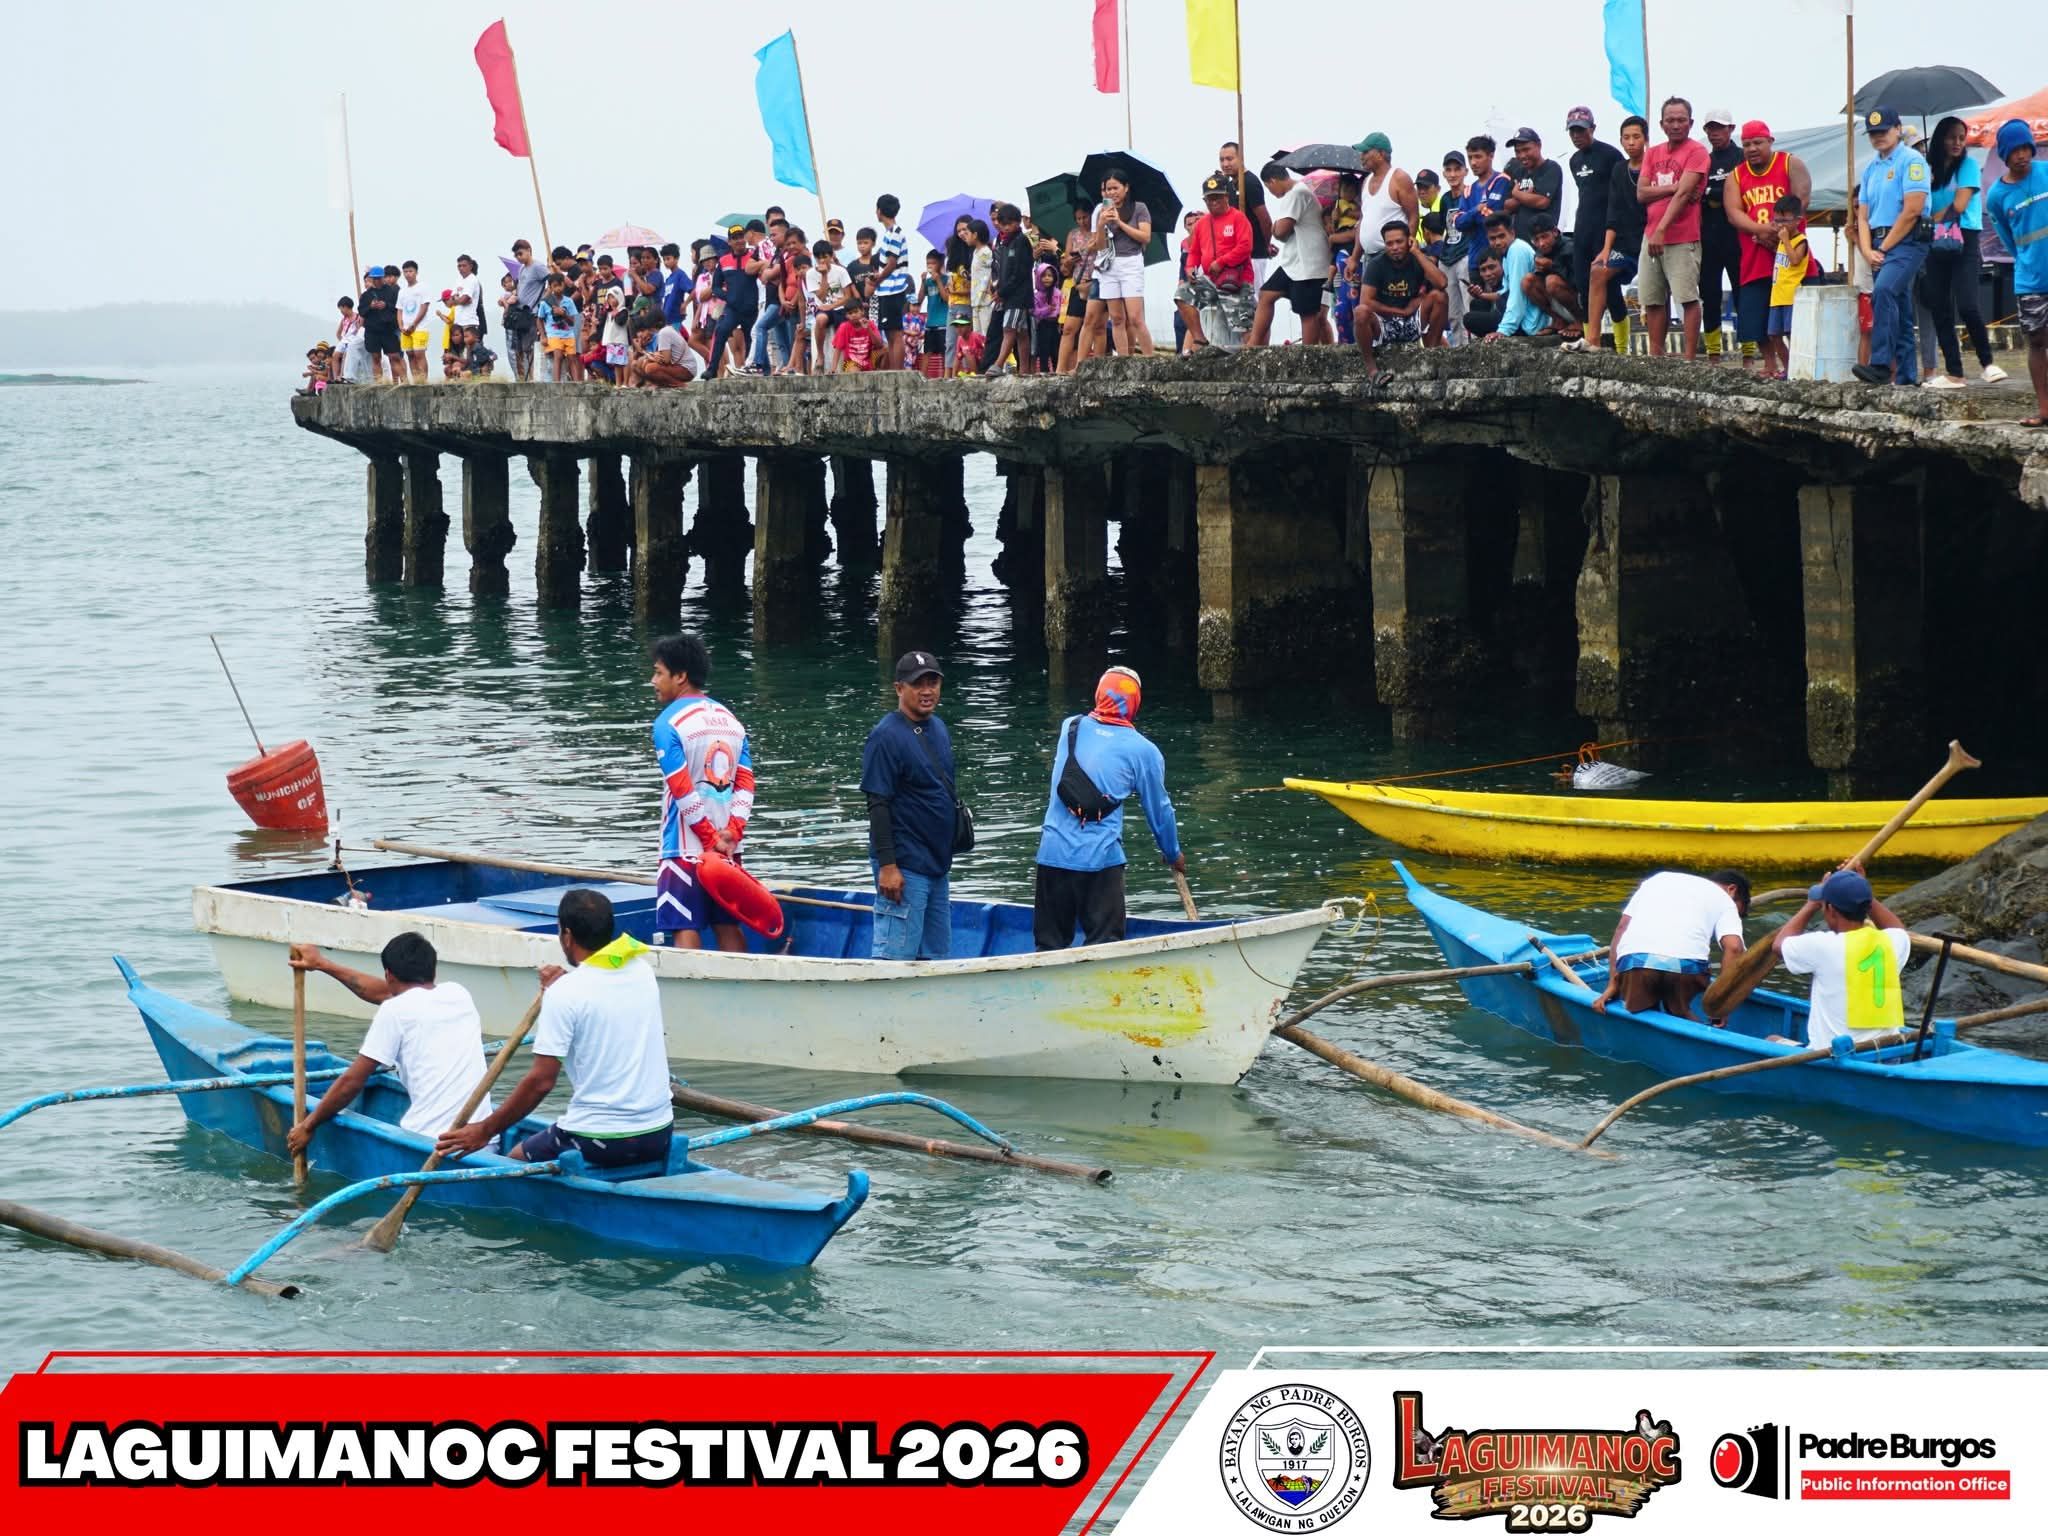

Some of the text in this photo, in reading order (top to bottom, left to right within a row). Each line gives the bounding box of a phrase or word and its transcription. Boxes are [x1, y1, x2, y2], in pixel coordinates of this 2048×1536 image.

[1757, 208, 1770, 225] 8
[297, 791, 317, 810] OF
[1858, 945, 1885, 1009] 1
